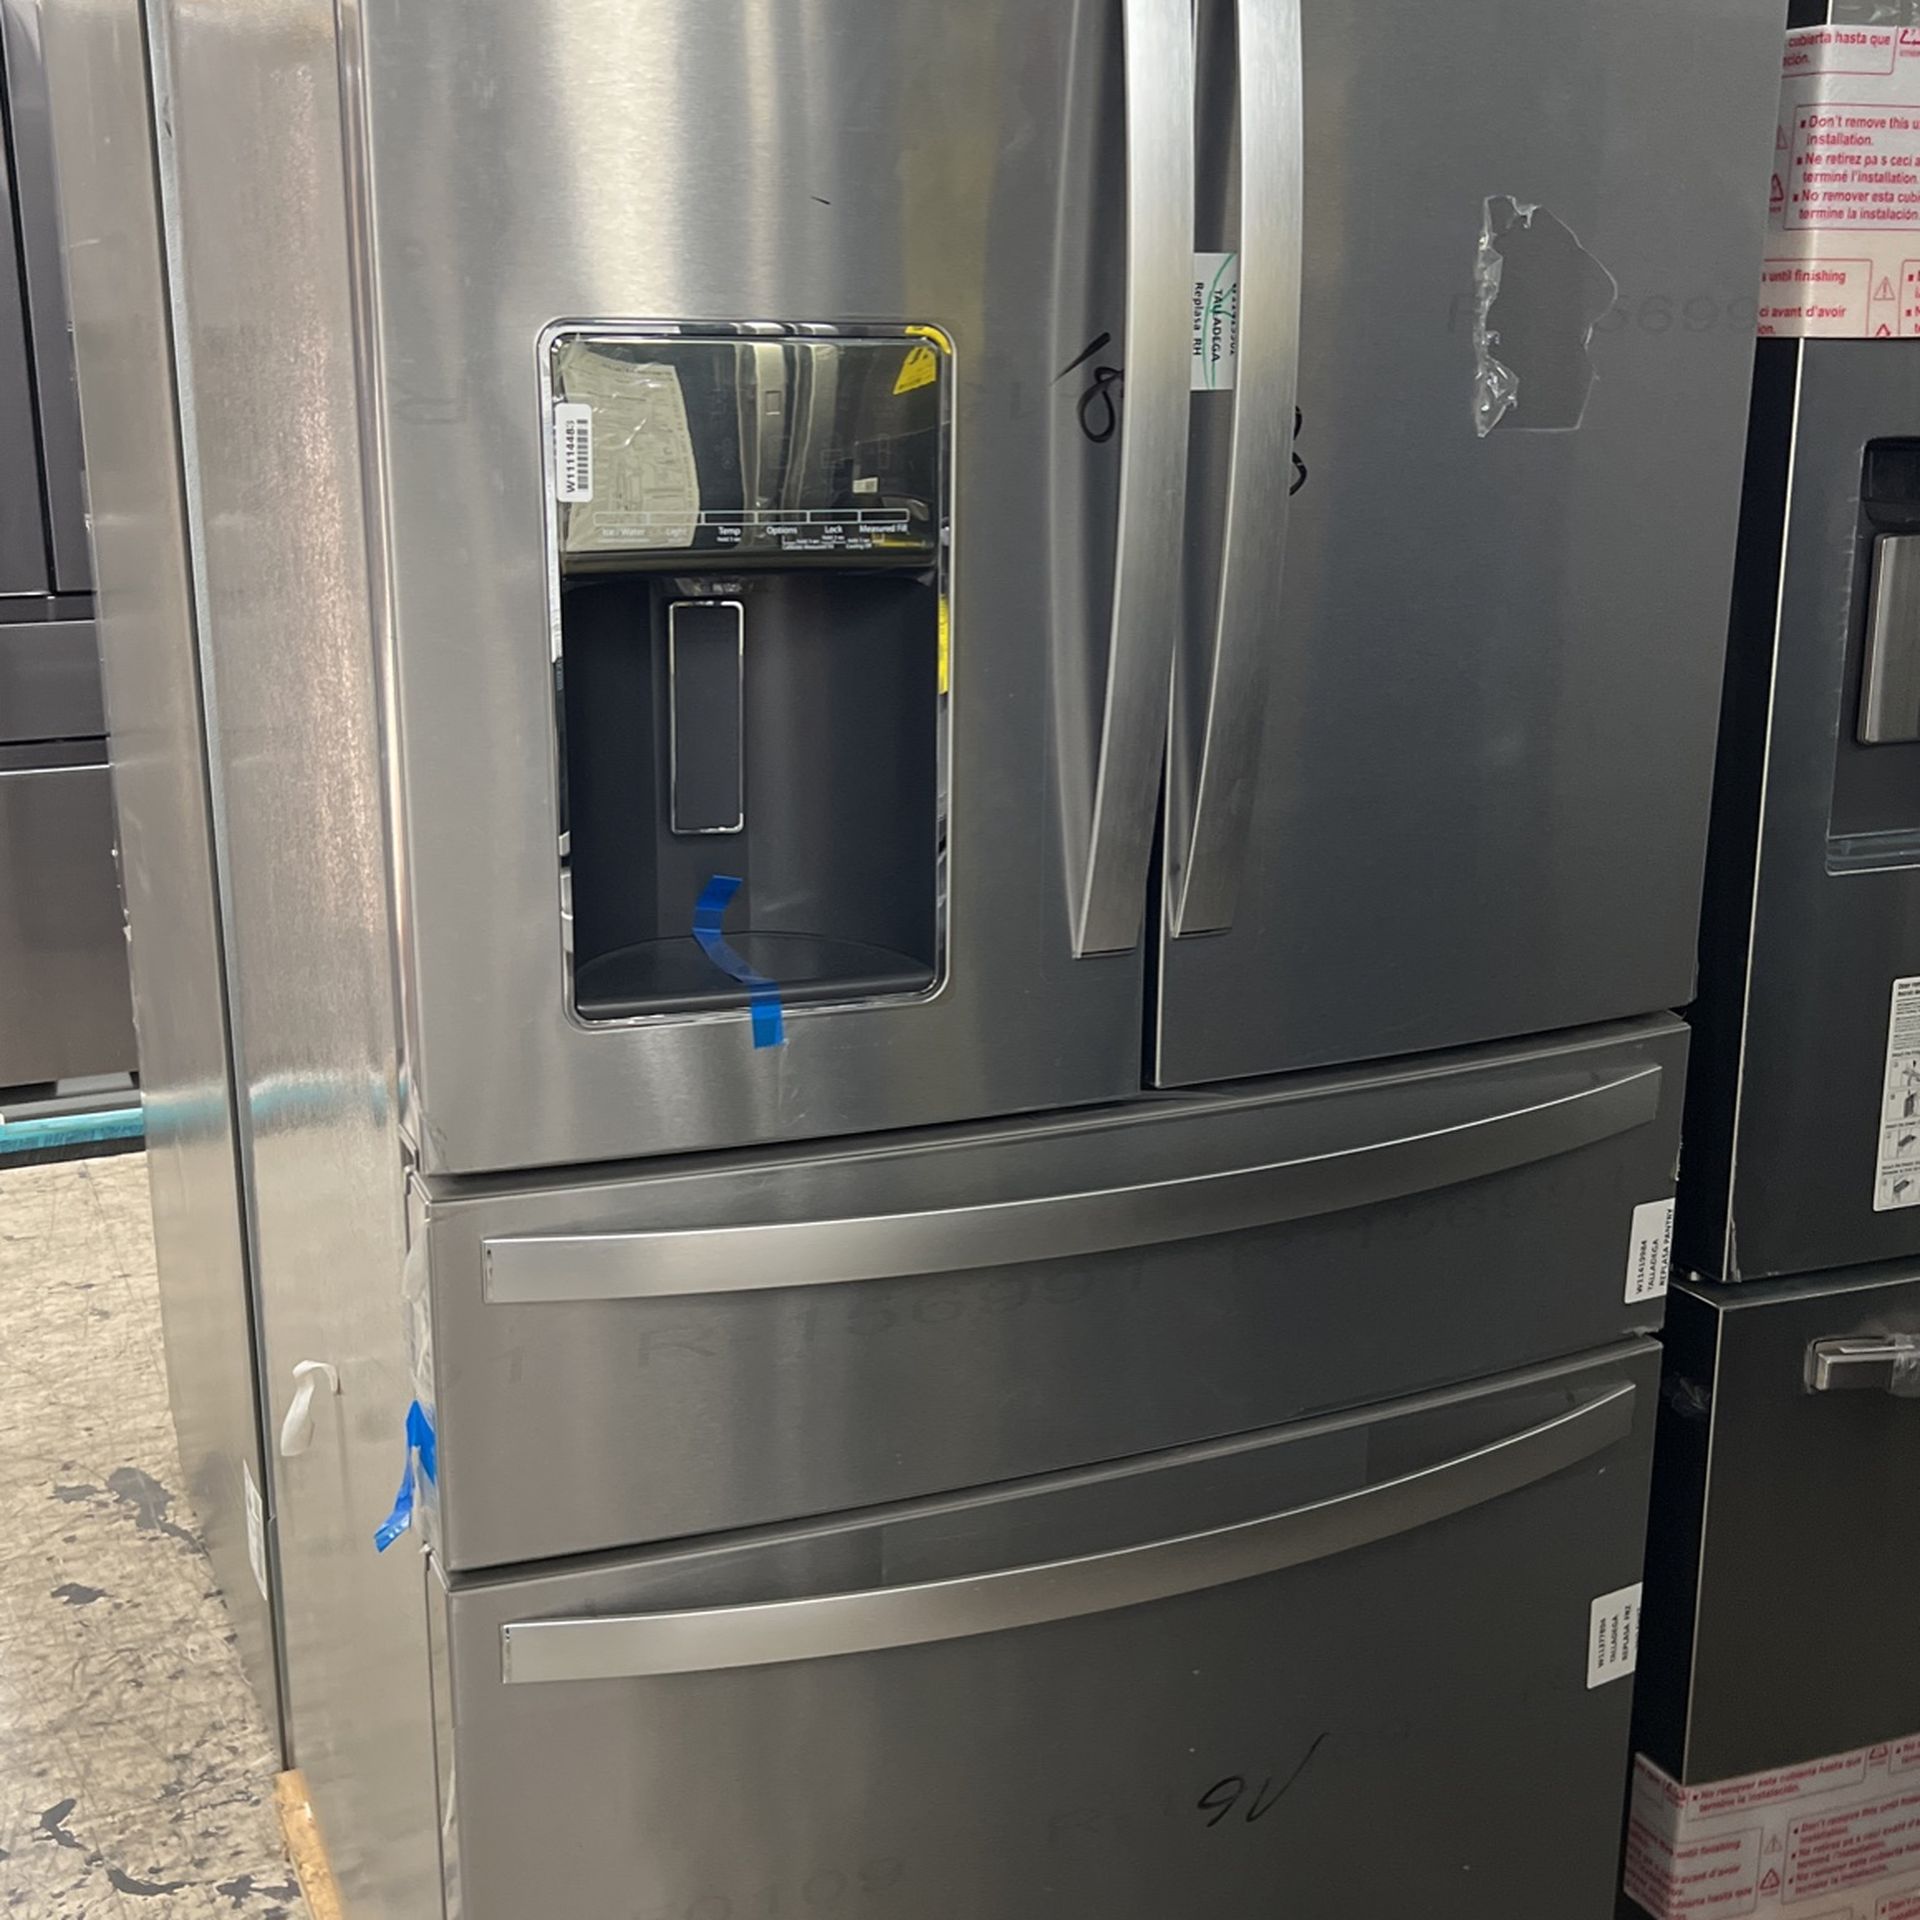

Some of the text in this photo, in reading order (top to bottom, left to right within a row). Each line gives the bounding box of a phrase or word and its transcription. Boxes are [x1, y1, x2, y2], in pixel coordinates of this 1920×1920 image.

[1788, 31, 1891, 48] cubierta hasta que
[1809, 115, 1842, 127] Don't
[1845, 117, 1887, 129] remove
[1889, 117, 1909, 129] this
[1806, 153, 1822, 165] Ne
[1826, 153, 1861, 165] retirez
[1890, 155, 1912, 167] ceci
[1803, 171, 1848, 183] terminé
[1802, 190, 1818, 201] No
[1823, 191, 1870, 201] remover
[1872, 191, 1895, 203] esta
[1799, 208, 1845, 220] termine
[1847, 208, 1857, 219] la
[1769, 269, 1792, 281] until
[1794, 270, 1846, 284] finishing
[1772, 306, 1802, 317] avant
[1806, 306, 1846, 317] d'avoir
[1193, 282, 1204, 356] Replasa RH
[1212, 290, 1222, 362] TALLADEGA
[621, 527, 645, 536] Water
[718, 526, 741, 536] Temp
[766, 526, 798, 536] Options
[824, 525, 843, 534] Lock
[859, 523, 908, 532] Measured Fill
[1648, 1239, 1658, 1291] TALLADEGA
